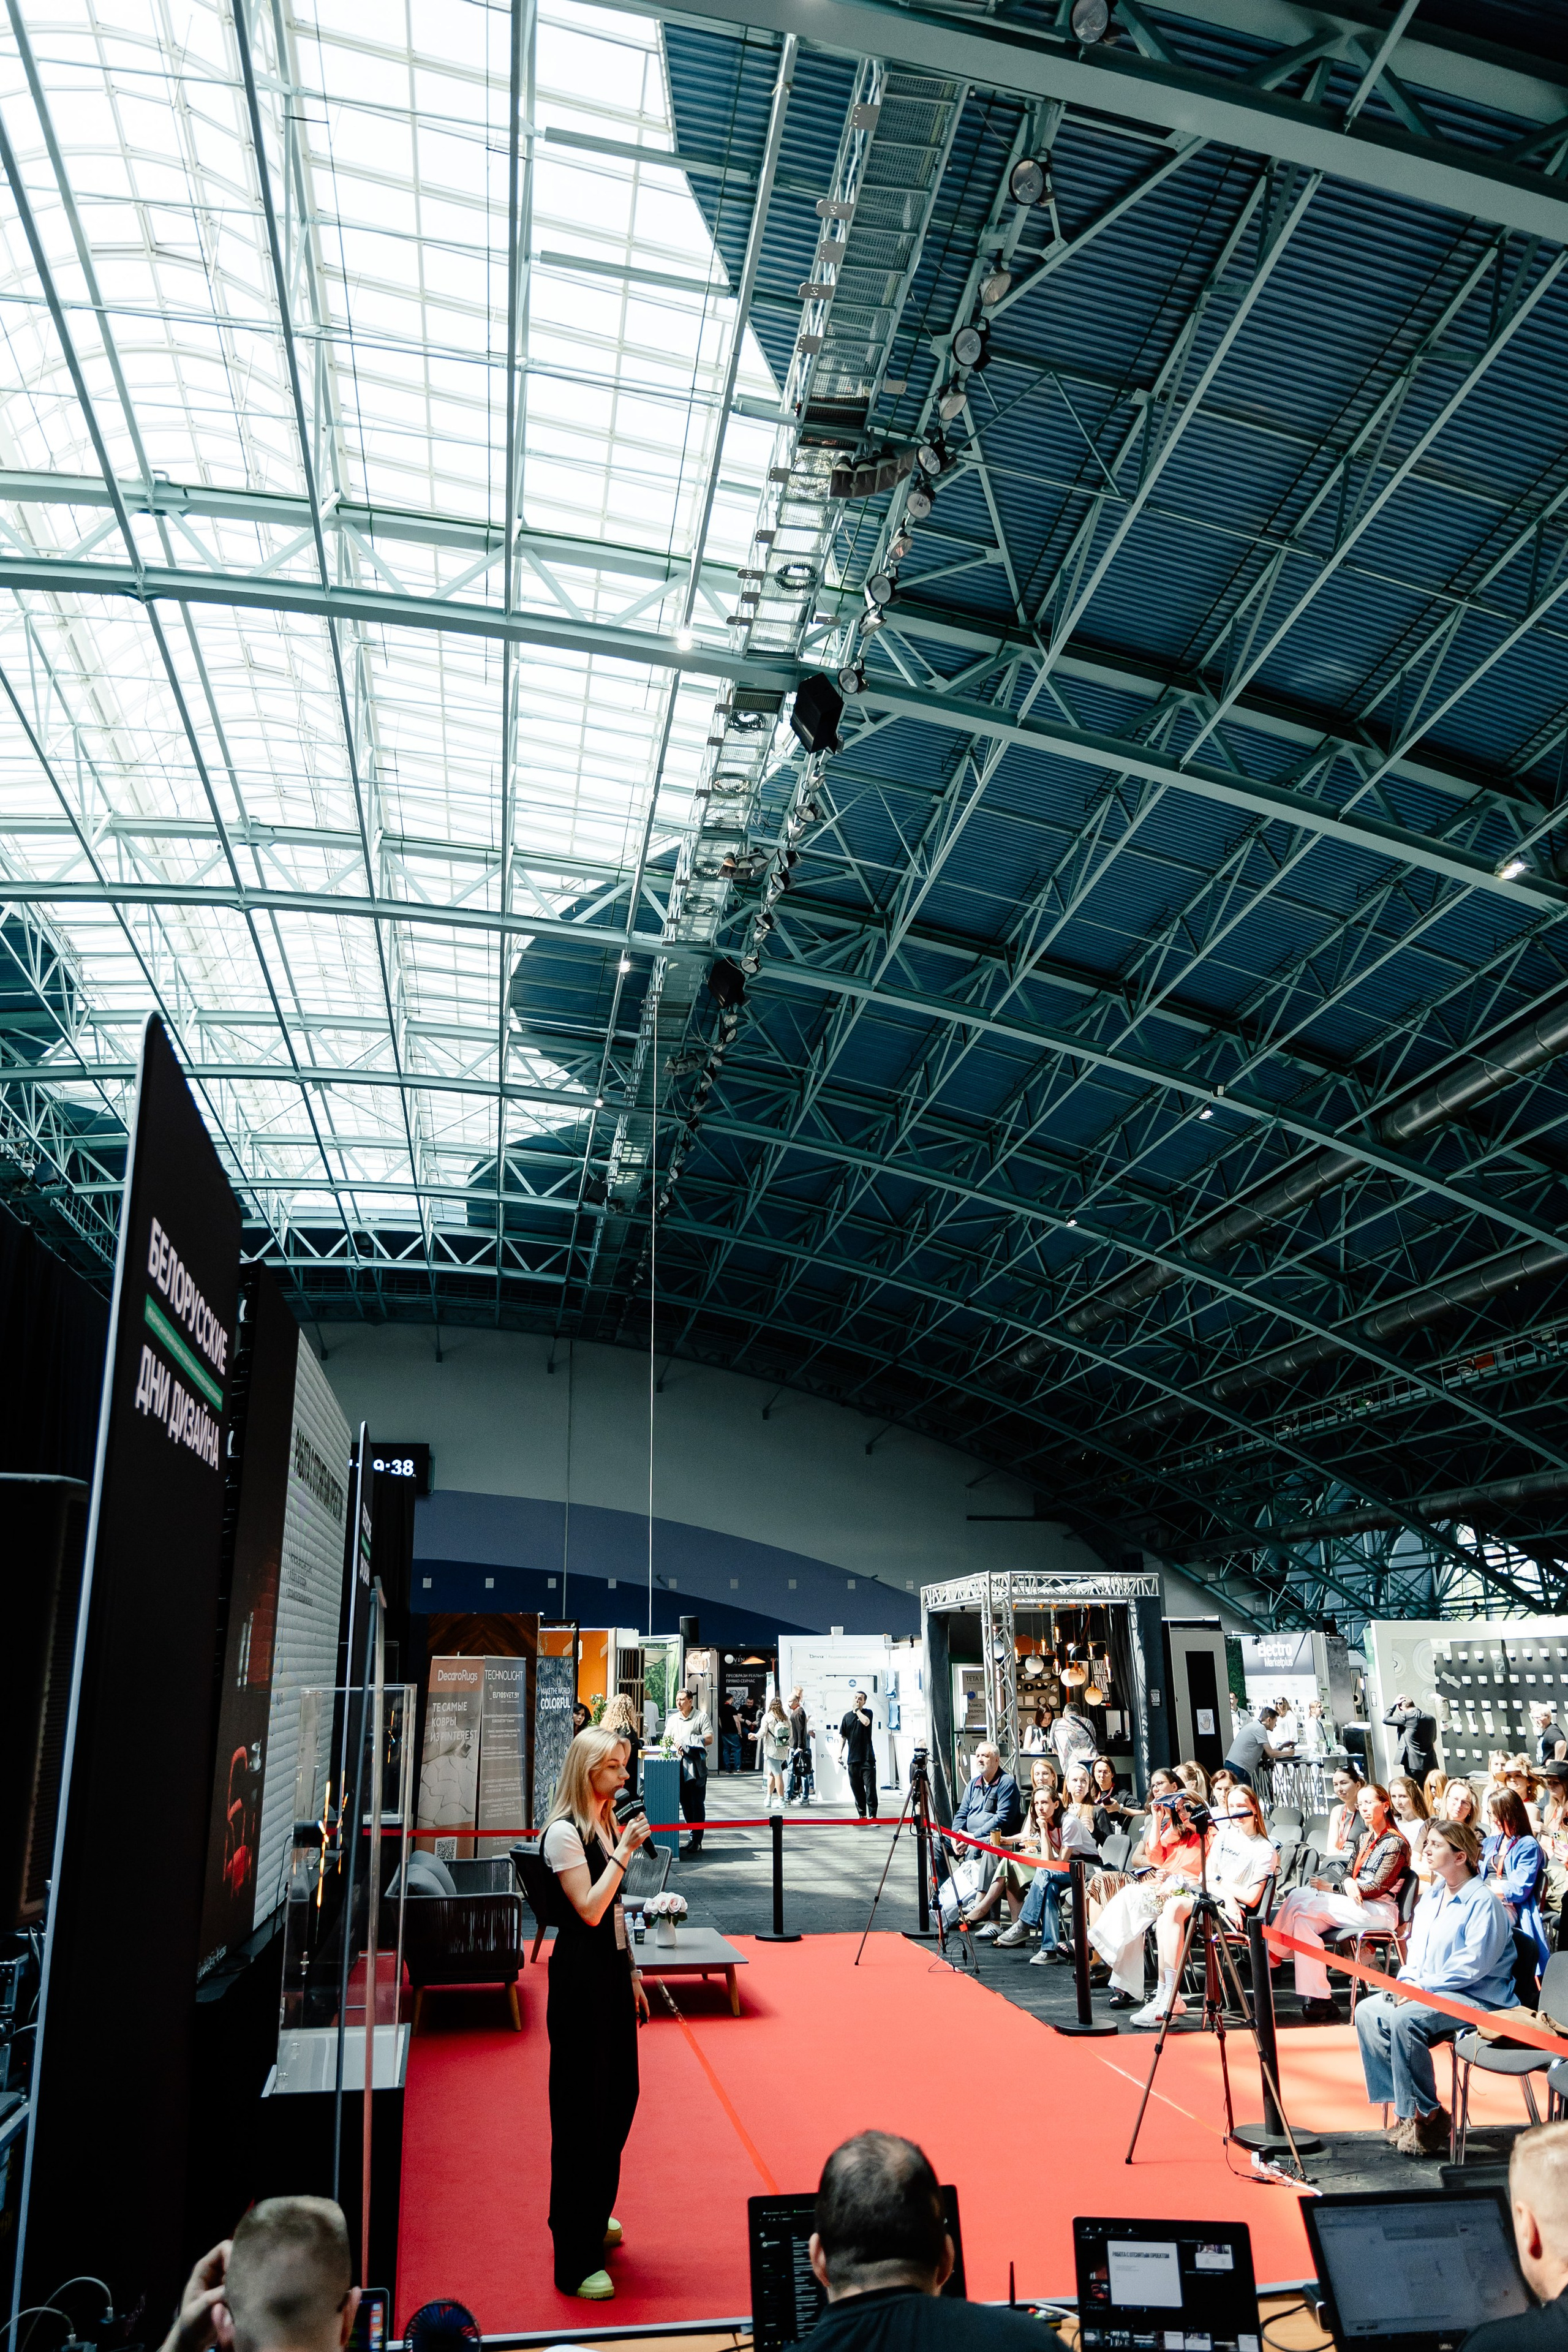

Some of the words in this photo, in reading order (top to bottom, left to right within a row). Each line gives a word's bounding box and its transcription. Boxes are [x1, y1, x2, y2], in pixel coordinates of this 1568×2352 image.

[148, 1217, 228, 1376] БЕЛОРУССКИЕ
[135, 1344, 171, 1423] ДНИ
[168, 1380, 219, 1471] ДИЗАЙНА
[1257, 1641, 1292, 1657] Electro
[1264, 1657, 1294, 1669] Marketplus
[438, 1670, 478, 1684] DecaroRugs
[484, 1670, 524, 1681] TECHNOLIGHT
[432, 1703, 442, 1712] ТЕ
[442, 1702, 467, 1712] САМЫЕ
[540, 1697, 571, 1709] COLORFUL
[431, 1716, 456, 1727] КОВРЫ
[430, 1733, 440, 1742] ИЗ
[440, 1730, 478, 1741] PINTEREST
